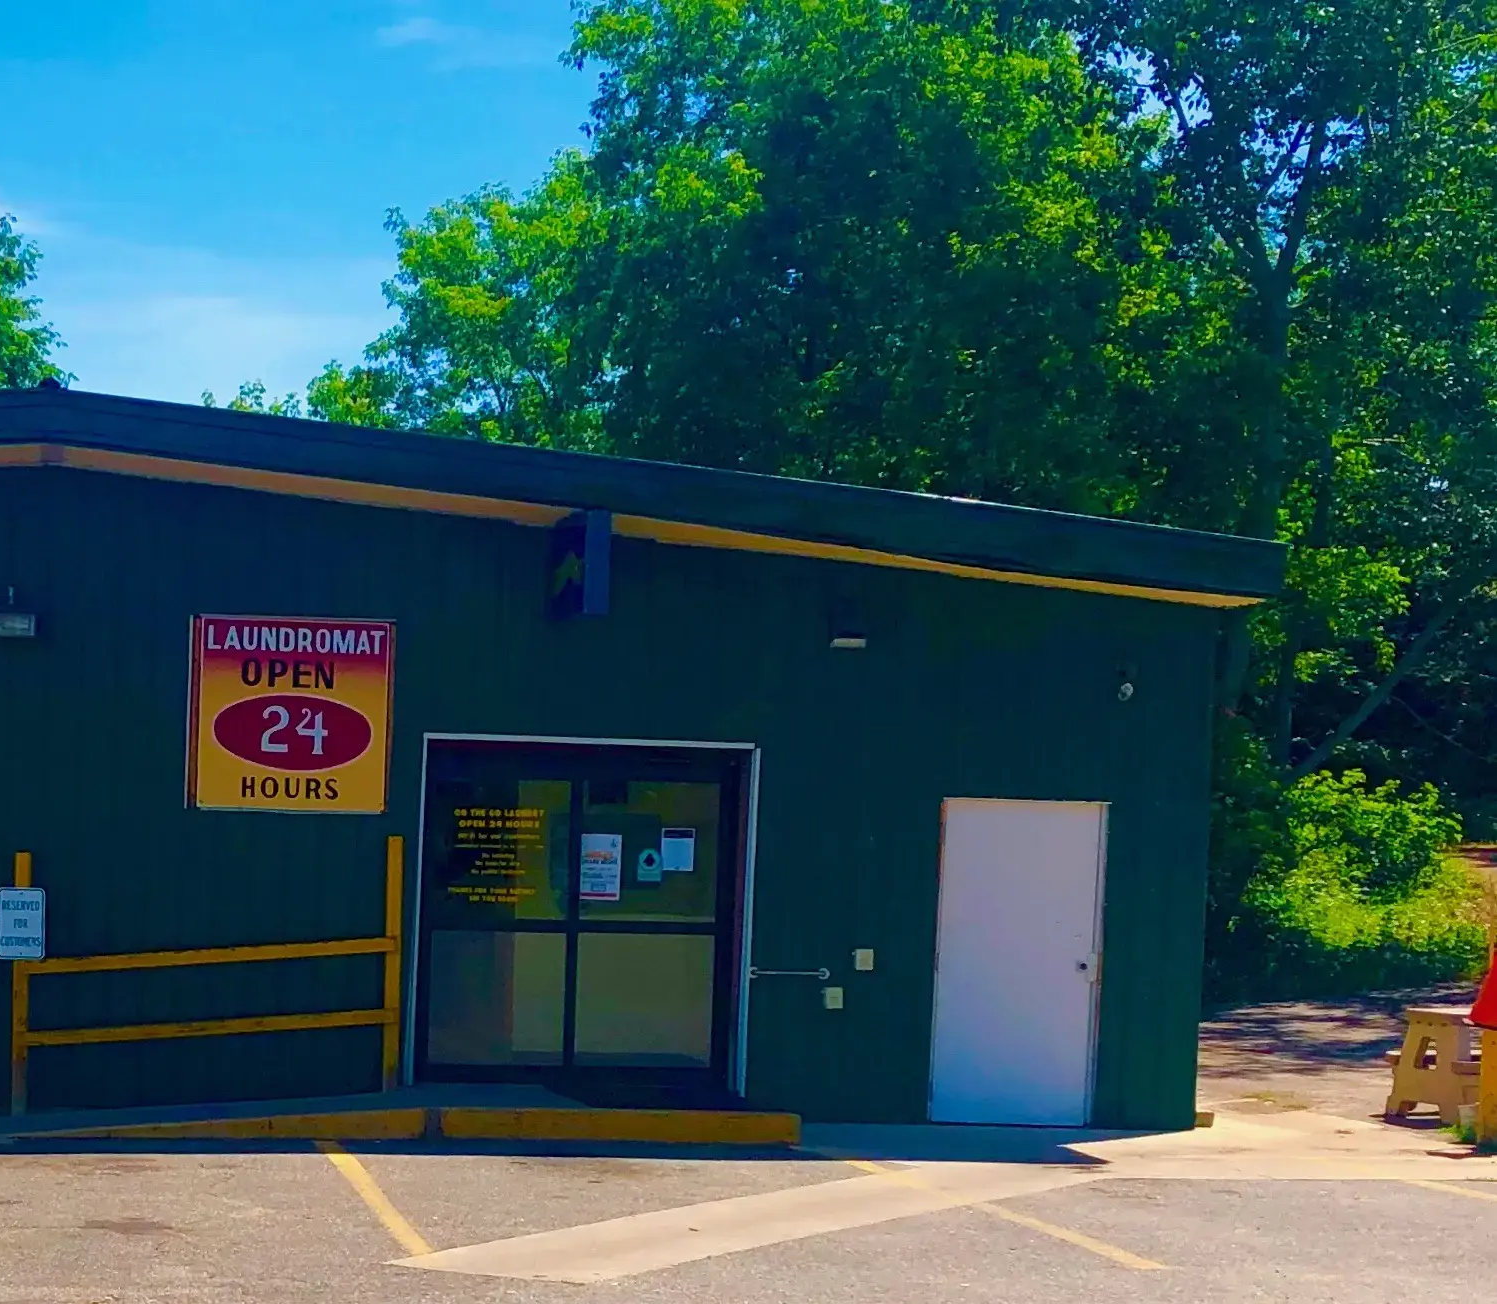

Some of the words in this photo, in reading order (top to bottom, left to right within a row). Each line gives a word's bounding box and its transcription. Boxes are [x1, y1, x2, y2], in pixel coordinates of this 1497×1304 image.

[207, 625, 385, 655] LAUNDROMAT
[241, 658, 334, 689] OPEN
[261, 705, 328, 755] 24
[241, 776, 339, 800] HOURS
[458, 820, 486, 828] OPEN
[2, 900, 40, 911] RESERVED
[13, 918, 28, 928] FOR
